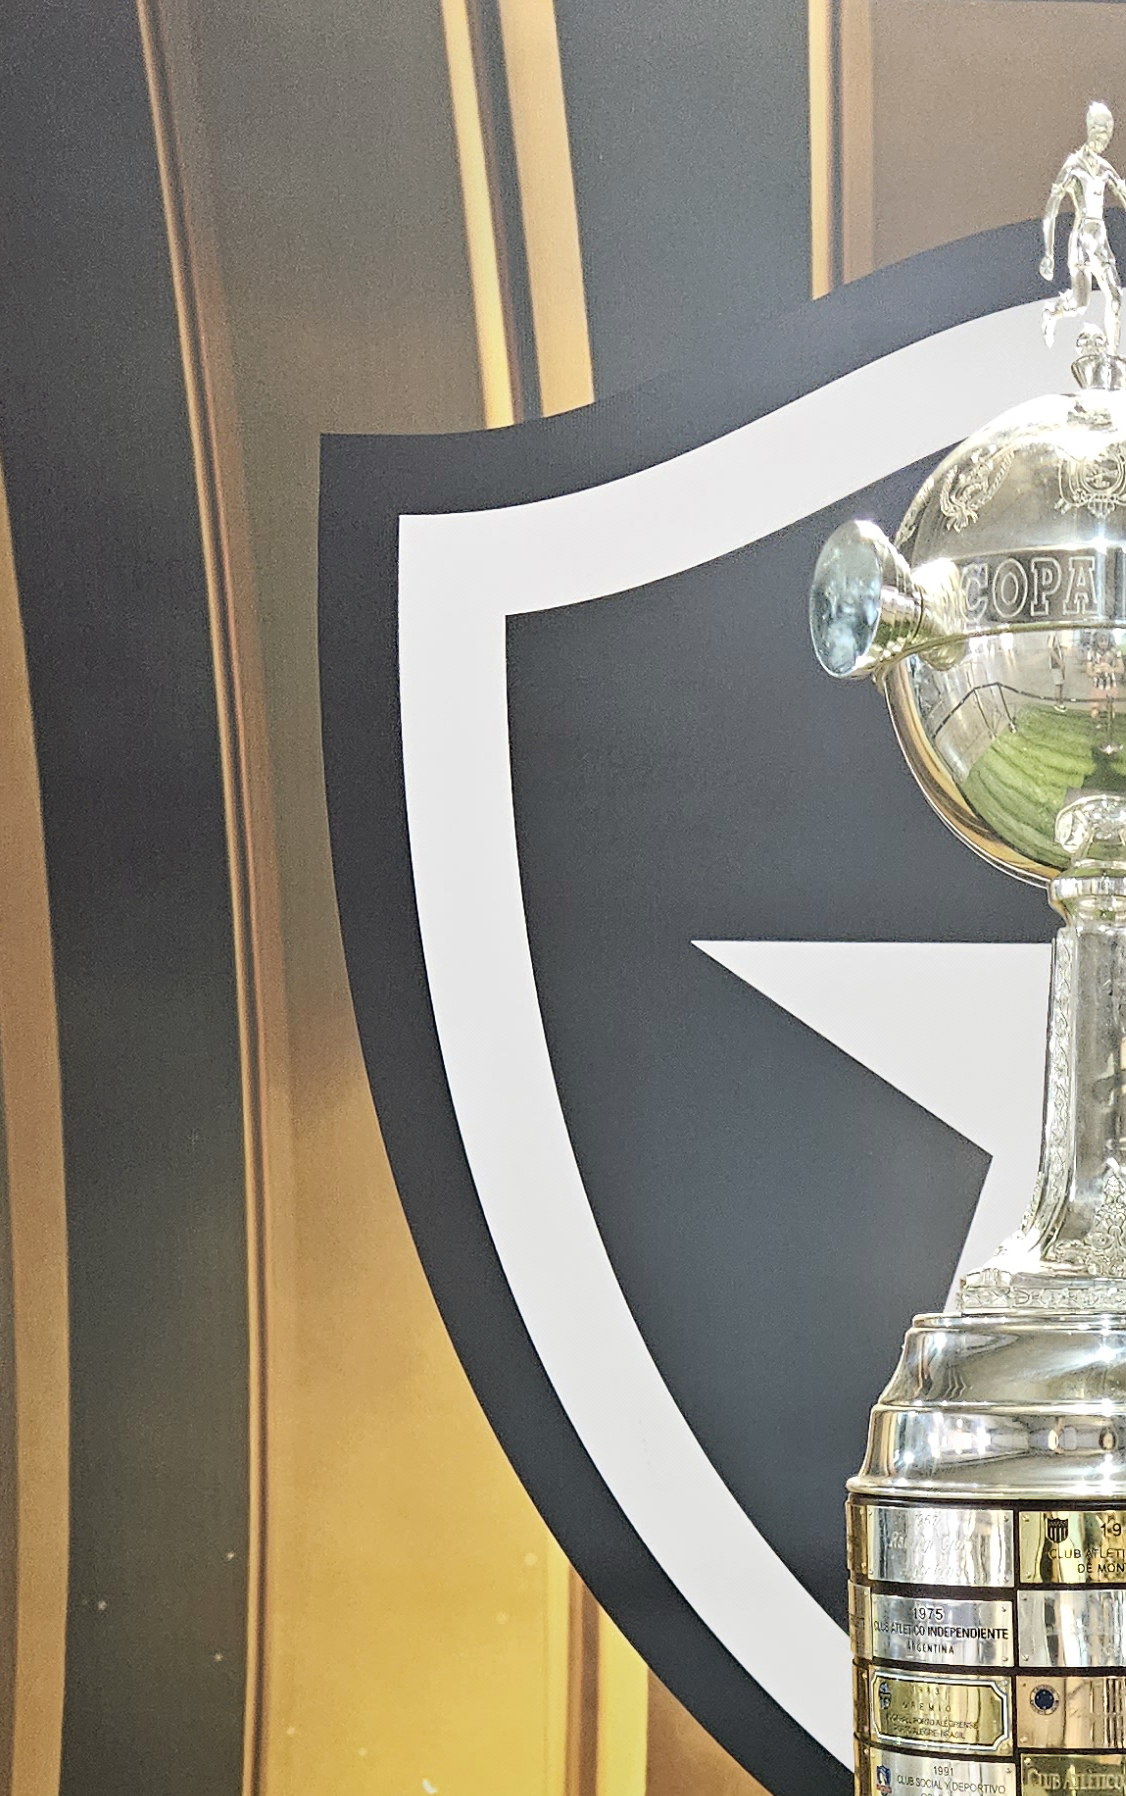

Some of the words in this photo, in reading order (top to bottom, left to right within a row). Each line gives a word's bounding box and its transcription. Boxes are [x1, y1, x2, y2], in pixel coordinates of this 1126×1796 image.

[959, 556, 1098, 623] COPA
[1050, 1548, 1082, 1559] CLUB
[1077, 1563, 1093, 1574] DE
[913, 1607, 944, 1621] 1975
[873, 1620, 889, 1633] CLUB
[927, 1626, 1009, 1640] INDEPENDIENTE
[907, 1640, 955, 1655] ARGENTINA
[933, 1765, 954, 1777] 1991
[896, 1774, 915, 1786] CLUB
[915, 1777, 943, 1790] SOCIAL
[944, 1781, 951, 1790] Y
[952, 1781, 1007, 1795] DEPORTIVO
